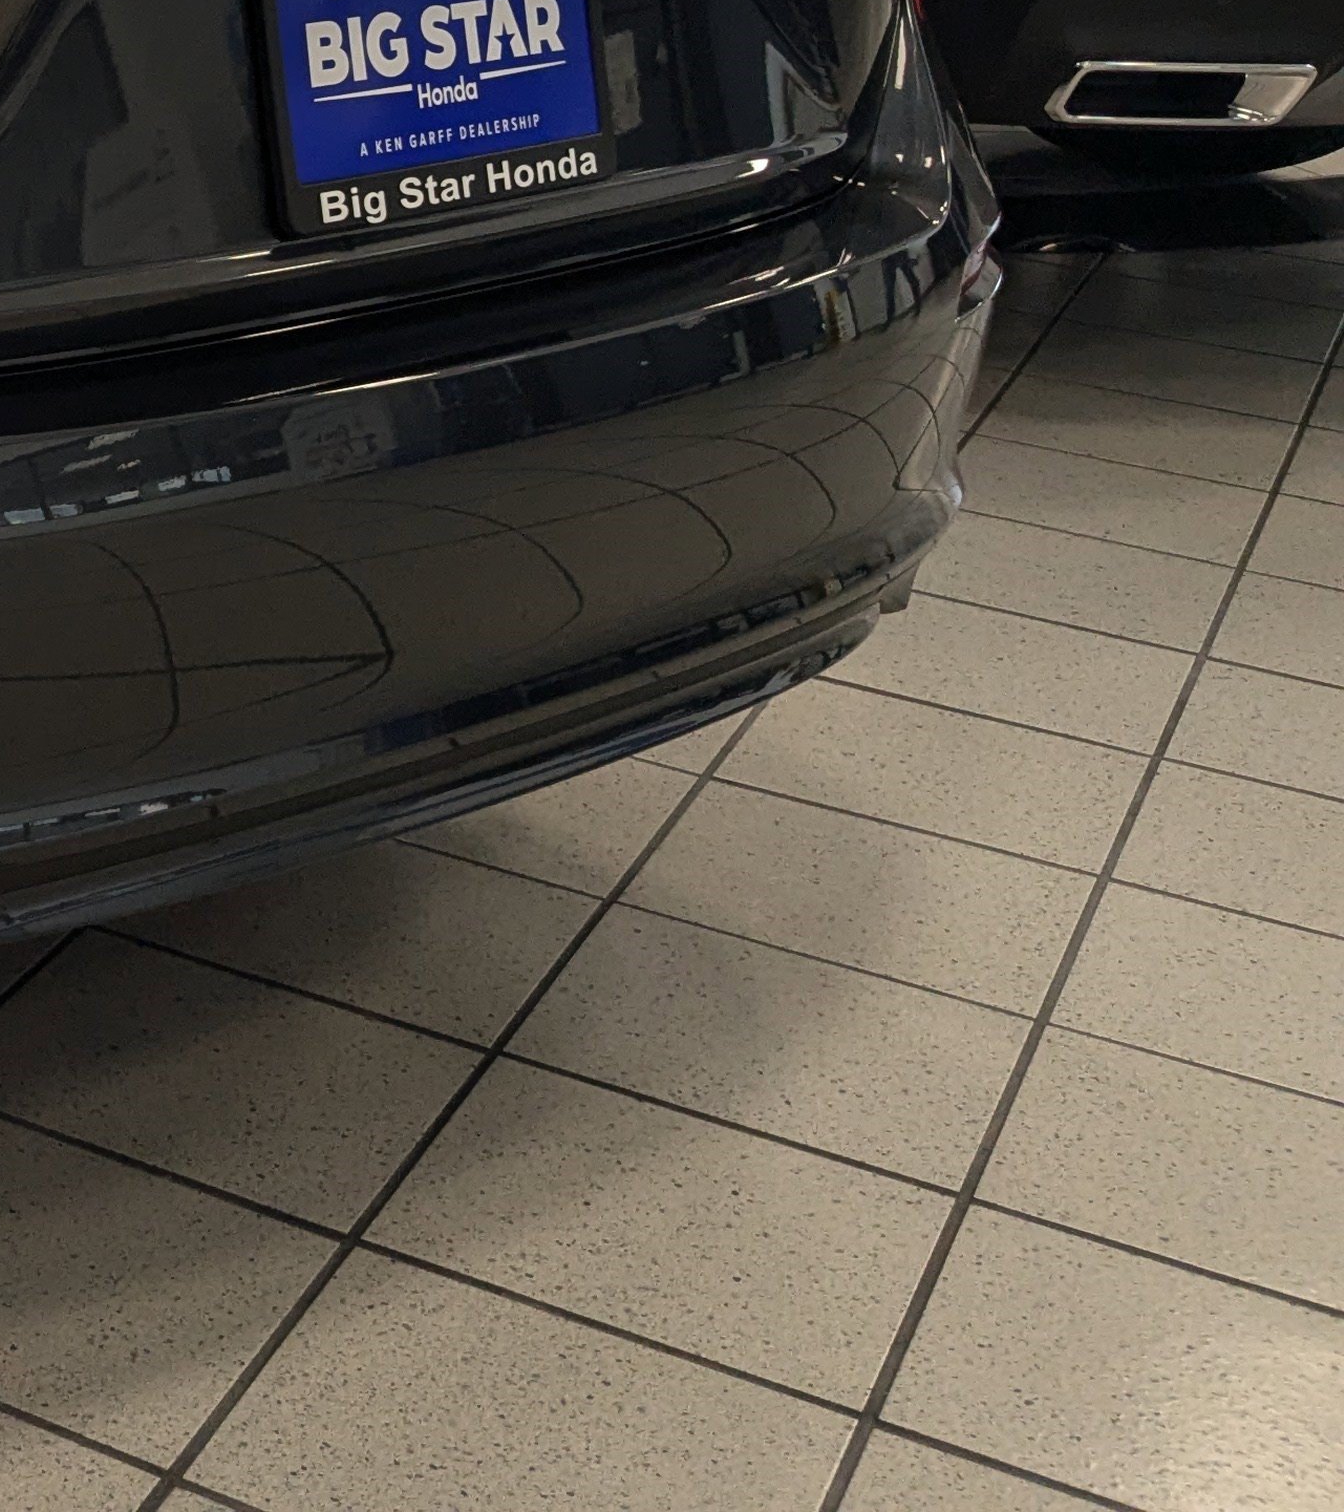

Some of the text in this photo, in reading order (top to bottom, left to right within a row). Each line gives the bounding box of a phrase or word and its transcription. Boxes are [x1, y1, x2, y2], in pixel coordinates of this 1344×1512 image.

[305, 11, 410, 88] BIG
[417, 75, 479, 109] Honda
[360, 113, 541, 157] A KEN GARFF DEALERSHIP
[319, 147, 598, 224] Big Star Honda
